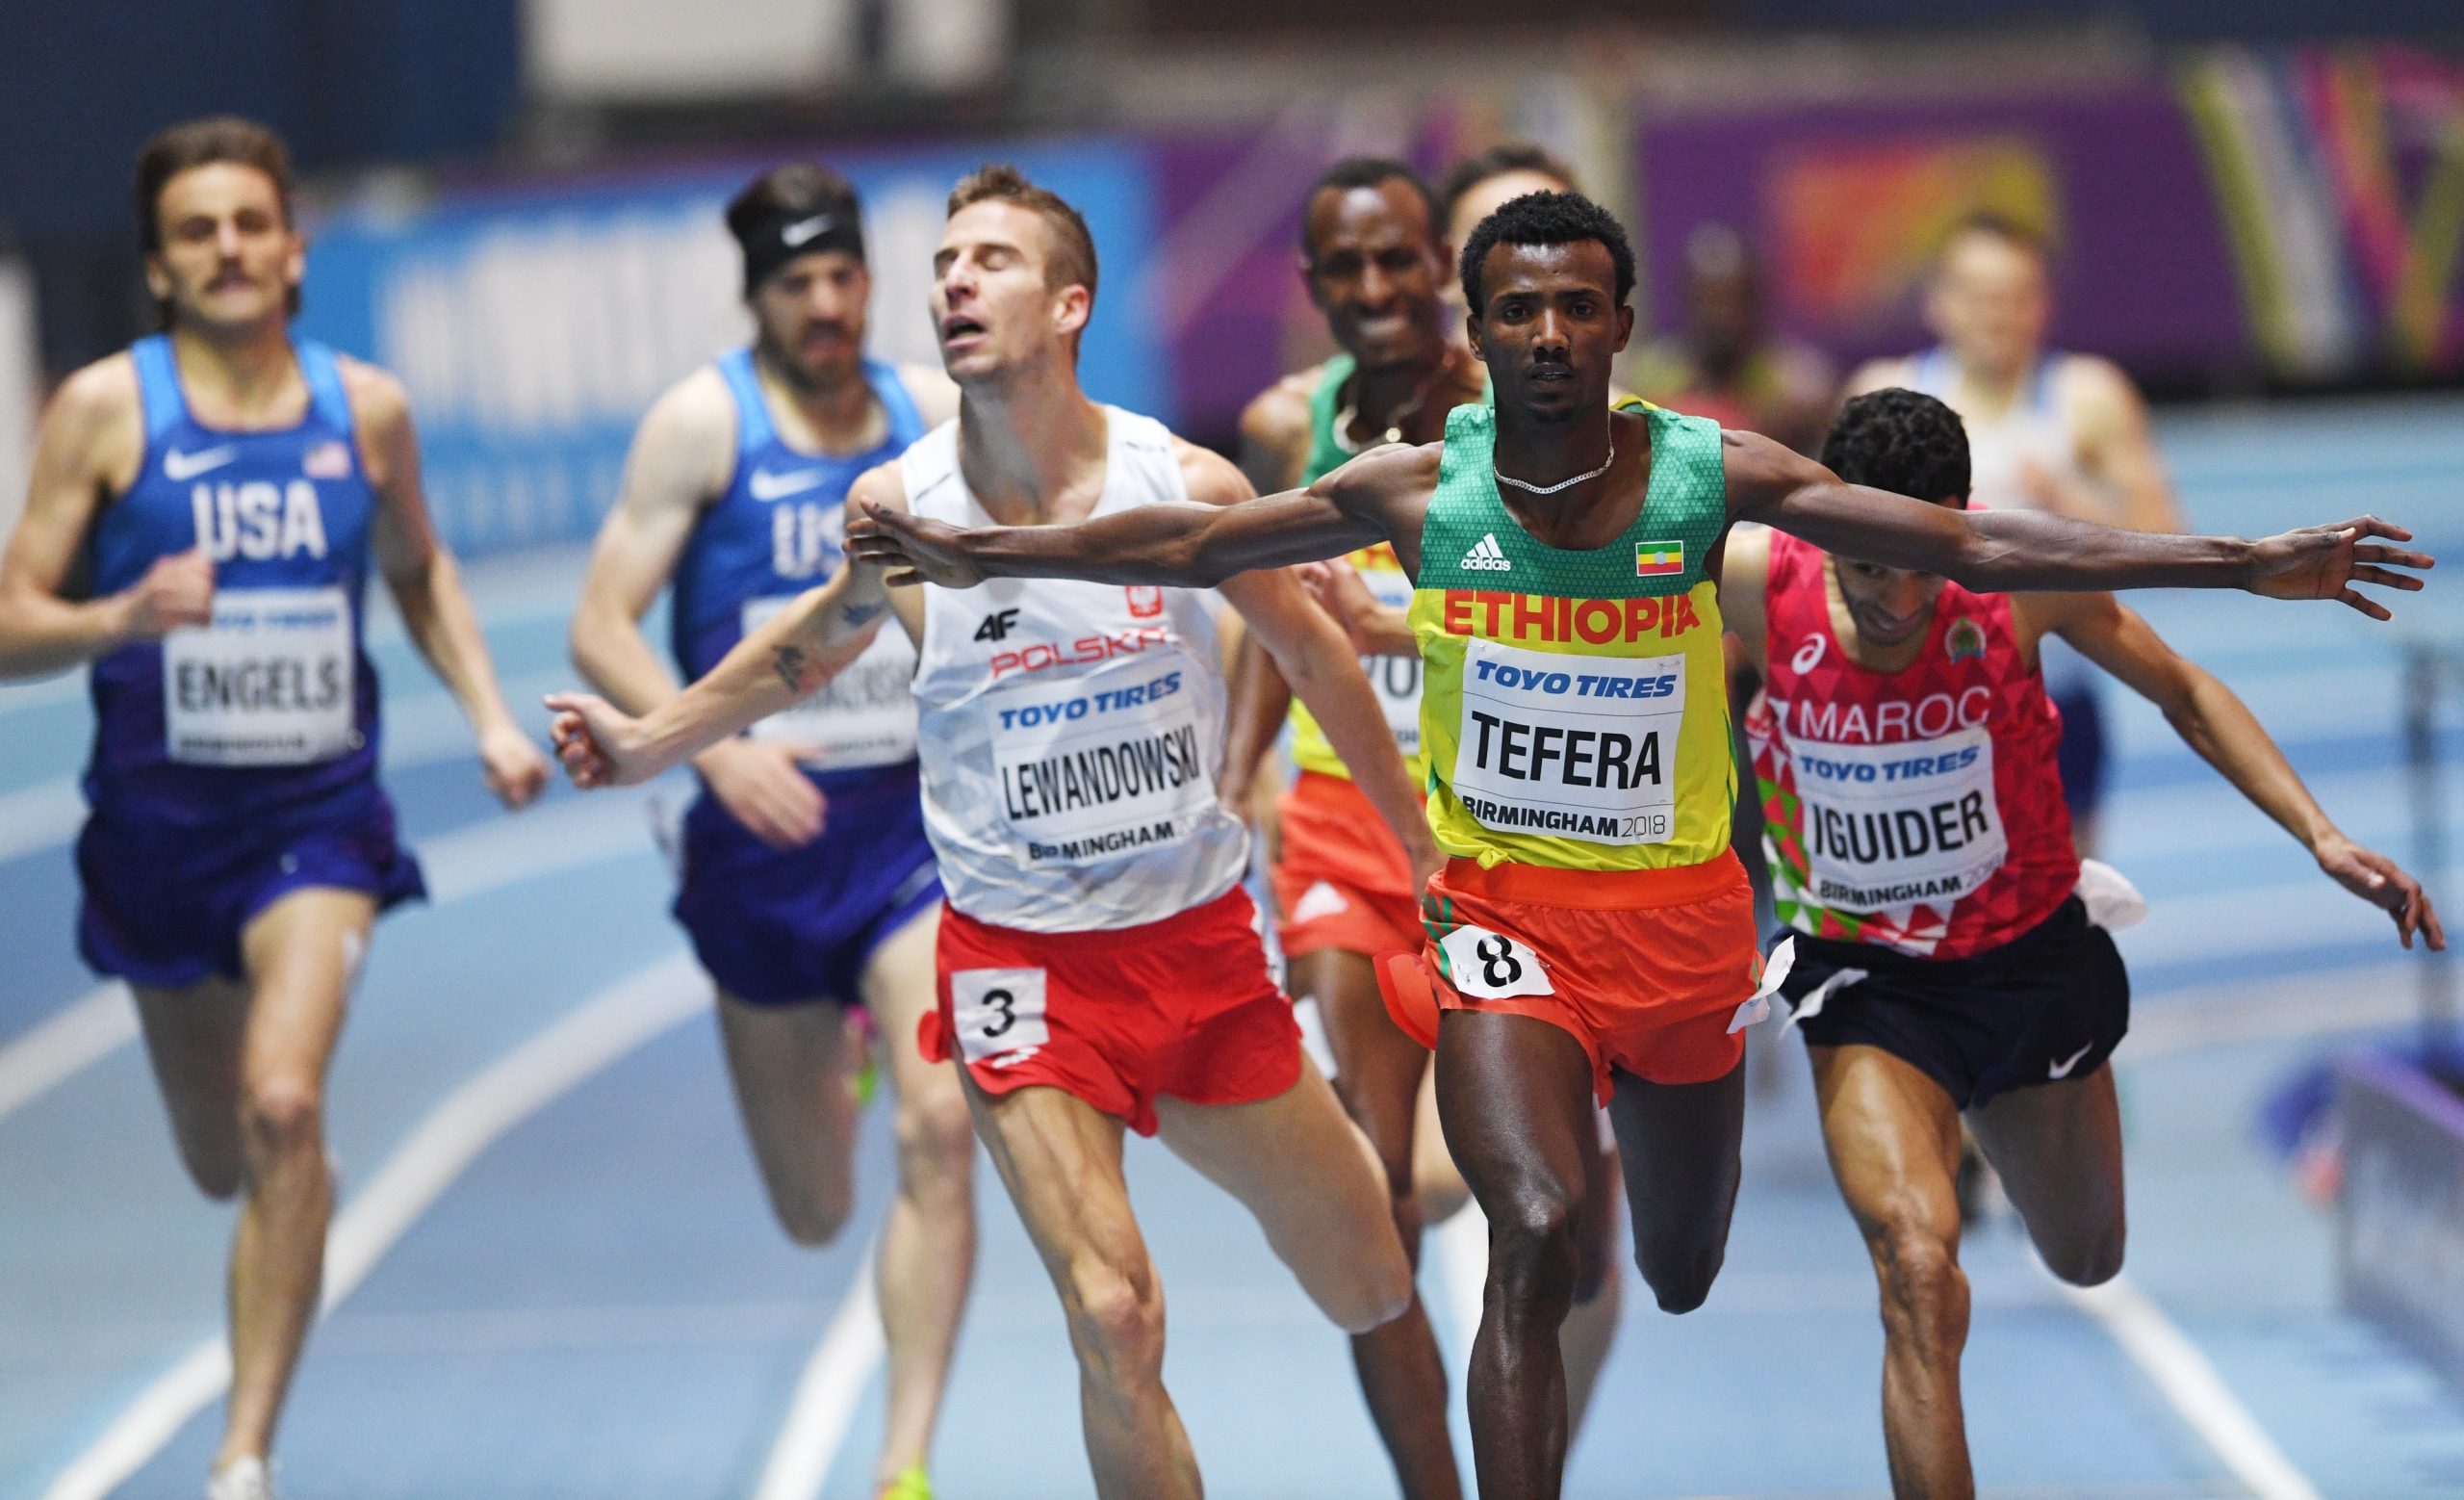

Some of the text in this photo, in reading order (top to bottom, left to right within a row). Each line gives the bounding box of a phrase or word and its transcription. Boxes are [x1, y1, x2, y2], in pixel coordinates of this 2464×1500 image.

[192, 480, 328, 560] USA
[1461, 558, 1511, 572] adidas
[1444, 588, 1701, 645] ETHIOPIA
[991, 627, 1168, 678] POLSKA
[1476, 659, 1678, 699] TOYO TIRES
[176, 658, 340, 712] ENGELS
[999, 672, 1182, 730] TOYO TIRES
[1799, 685, 1991, 743] MAROC
[1002, 724, 1200, 821] LEWANDOWSKI
[1471, 710, 1662, 790] TEFERA
[1800, 744, 1981, 784] TOYO TIRES
[1461, 794, 1666, 839] BIRMINGHAM 2018
[1811, 789, 1989, 864] IGUIDER
[1819, 875, 1963, 907] BIRMINGHAM
[1476, 934, 1522, 988] 8
[982, 988, 1016, 1038] 3
